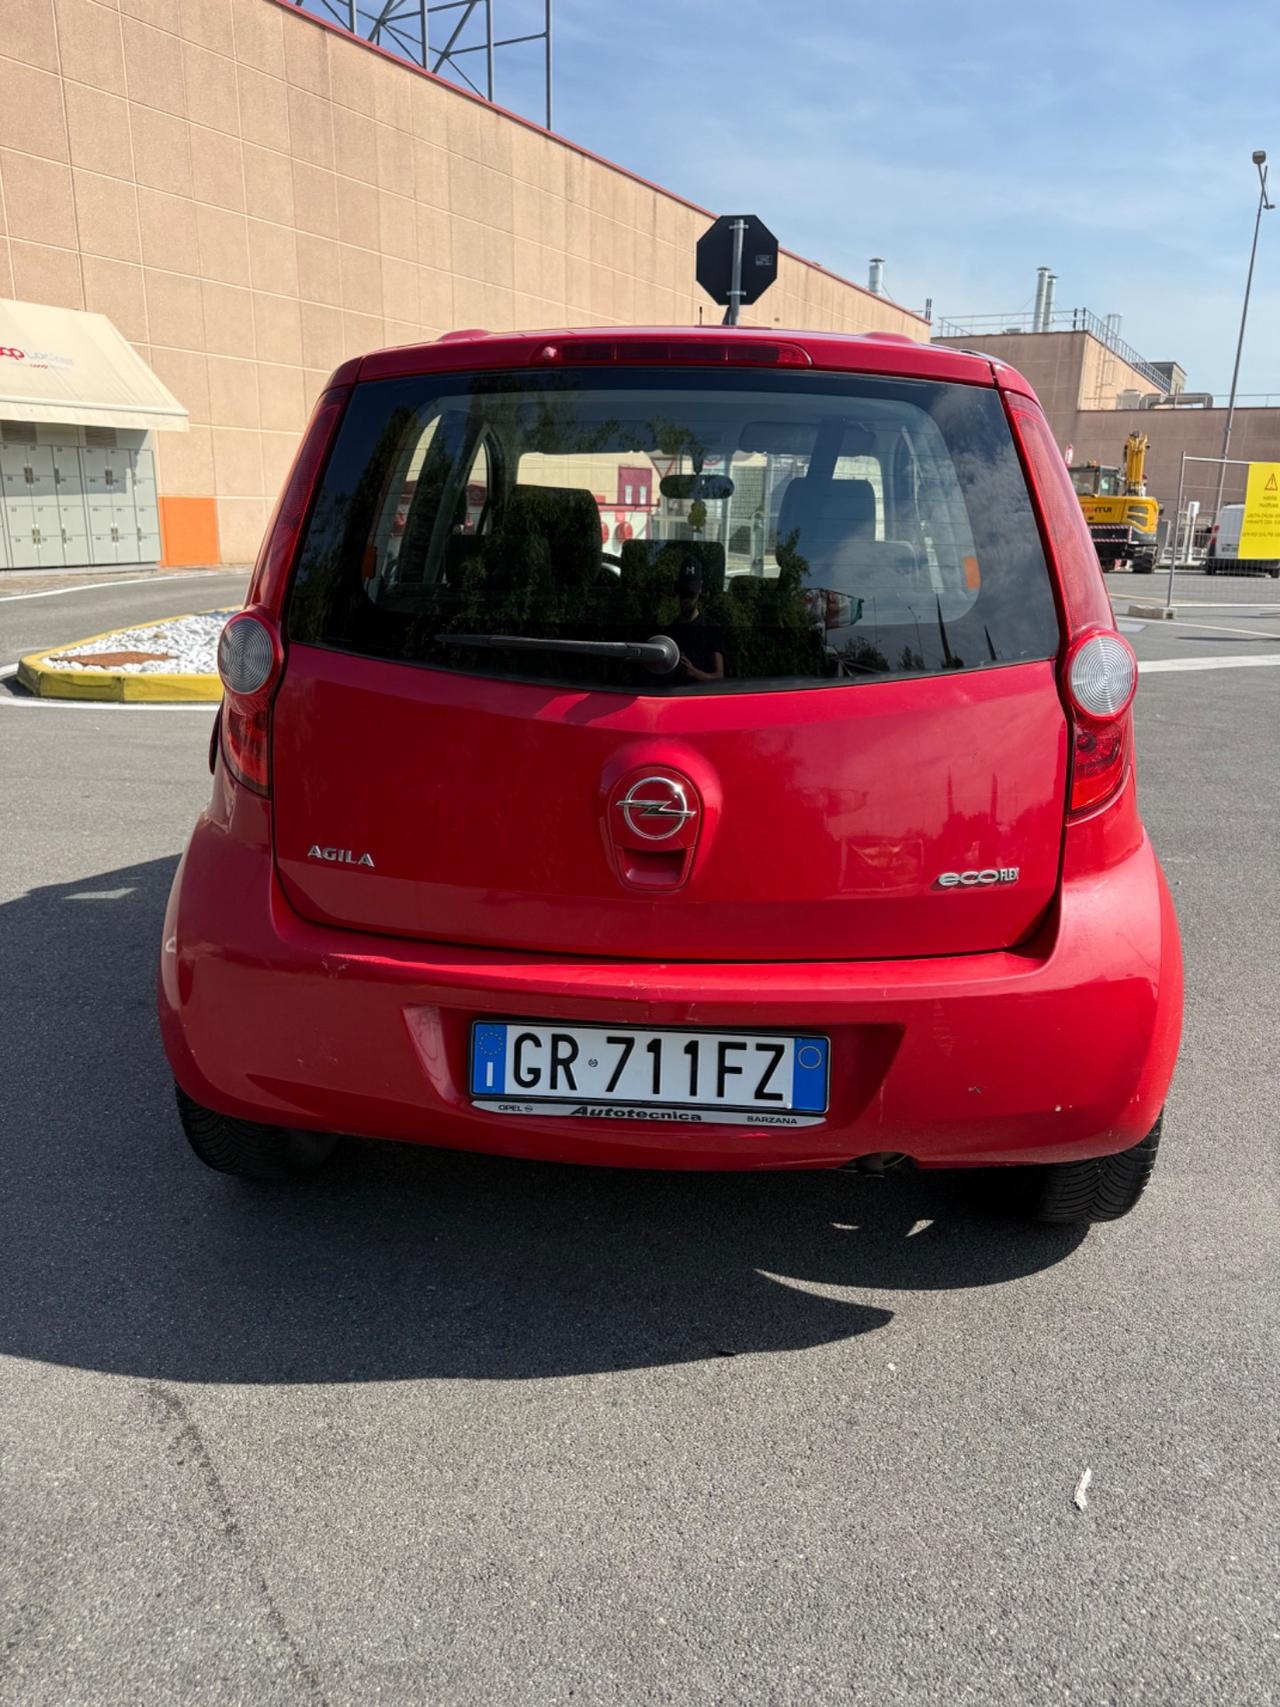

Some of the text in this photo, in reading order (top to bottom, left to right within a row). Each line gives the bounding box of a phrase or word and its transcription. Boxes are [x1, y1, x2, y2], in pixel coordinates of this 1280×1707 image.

[0, 346, 25, 361] op
[307, 845, 375, 868] AGILA
[513, 1032, 786, 1101] GR 711FZ
[498, 1104, 522, 1112] OPEL
[570, 1106, 702, 1121] Autotecnica
